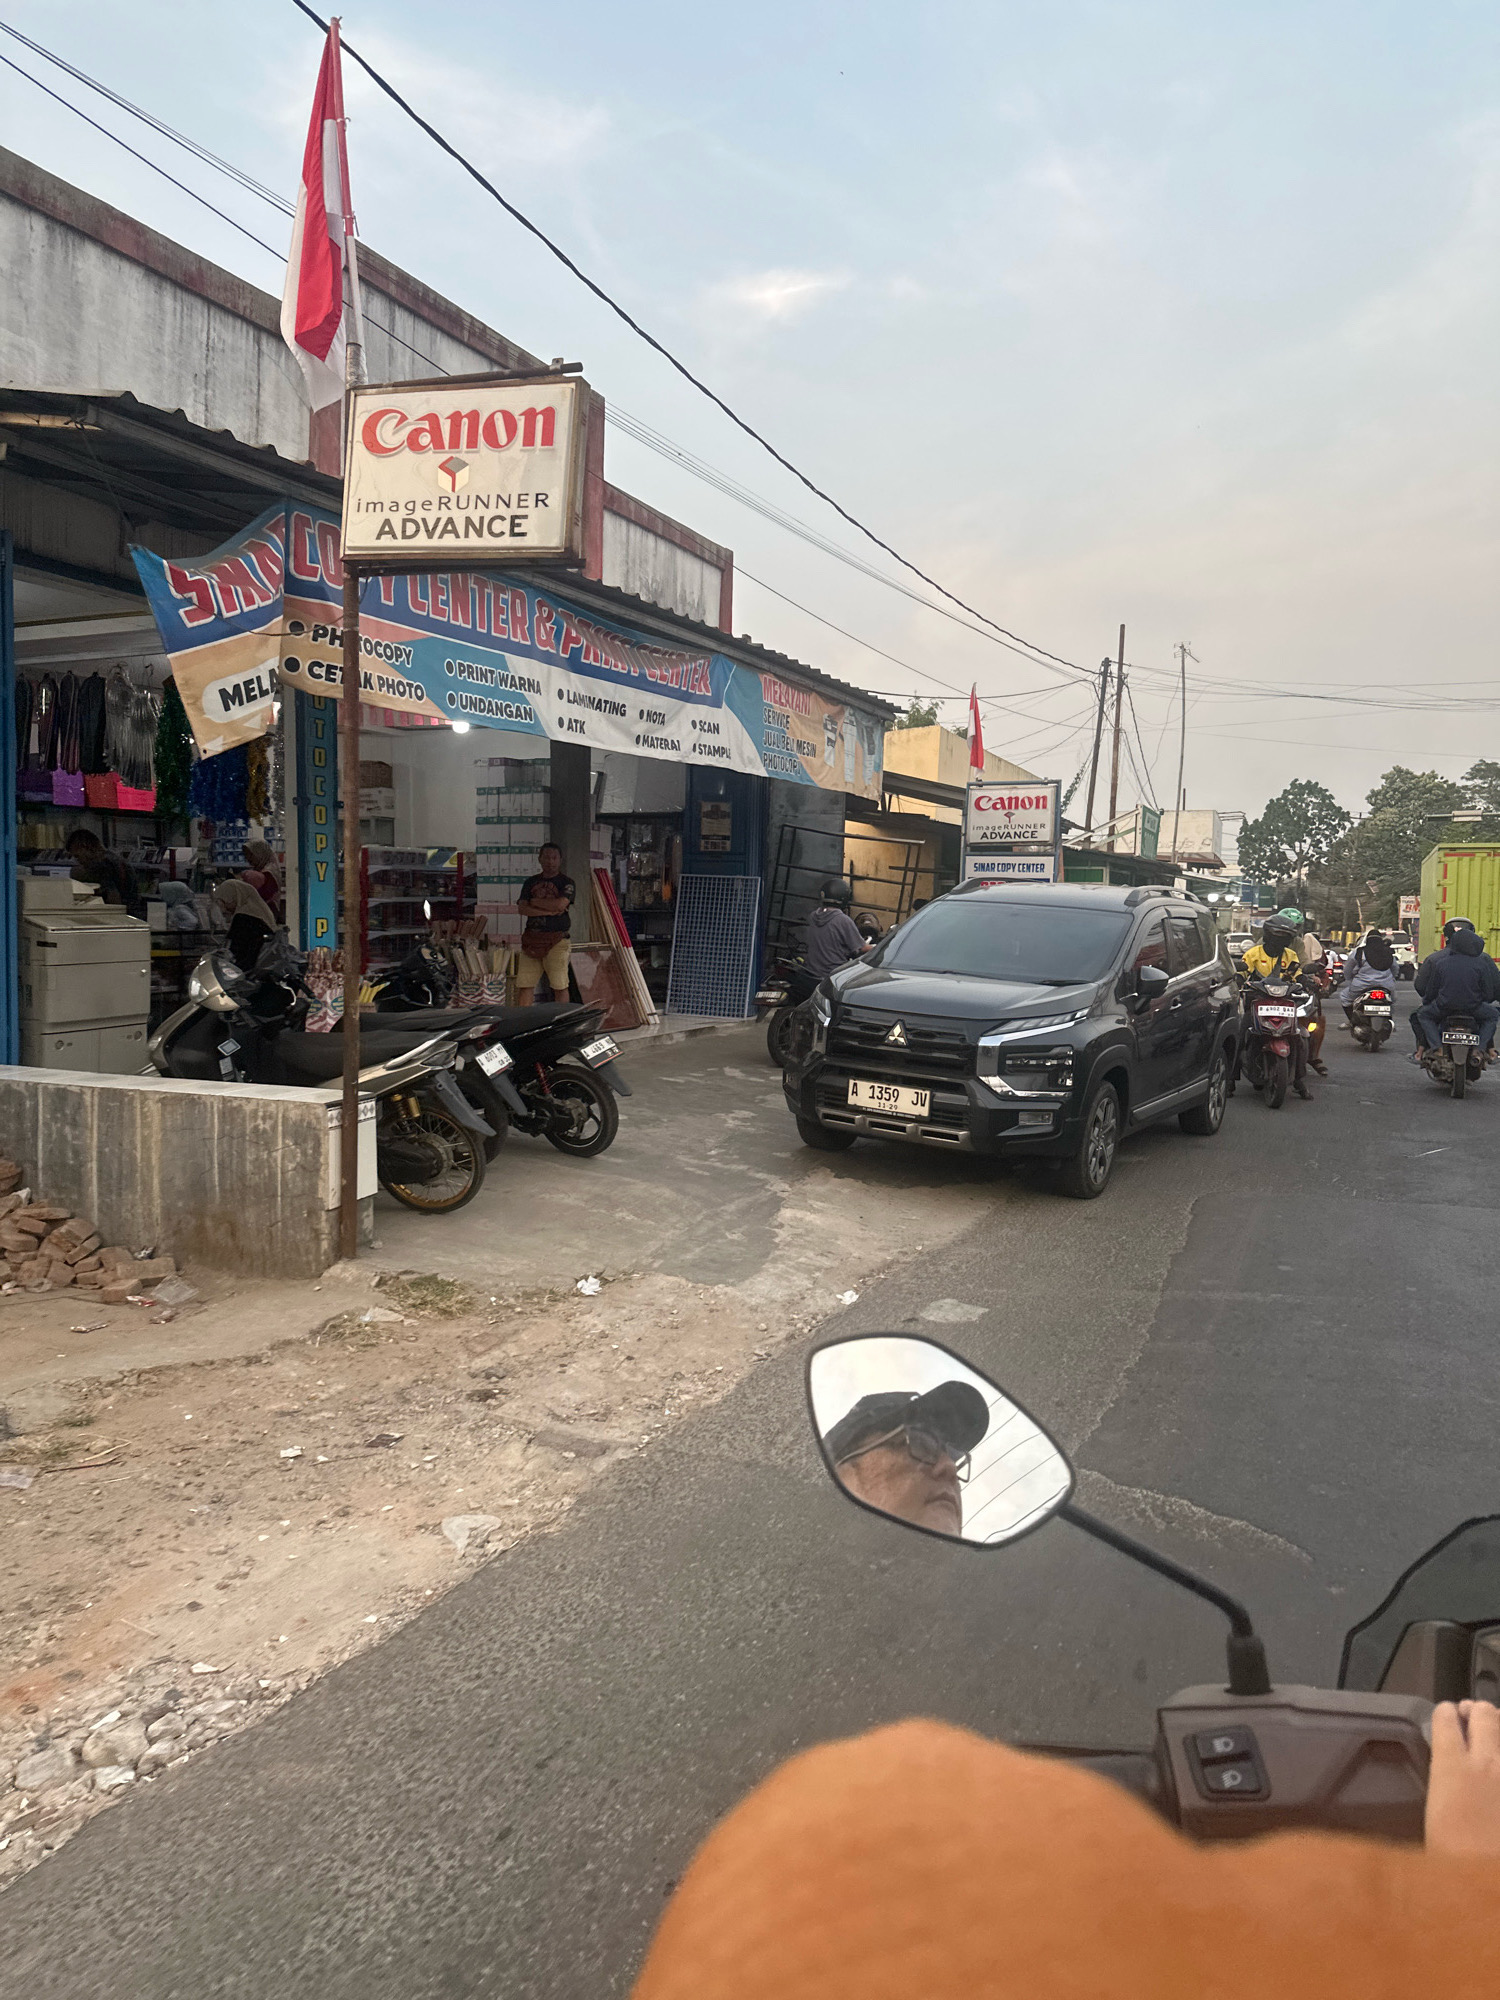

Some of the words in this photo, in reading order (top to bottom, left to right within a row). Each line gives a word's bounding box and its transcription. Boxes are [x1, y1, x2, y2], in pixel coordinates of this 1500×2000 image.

[361, 405, 556, 455] Canon
[356, 492, 550, 516] imageRUNNER
[375, 514, 529, 541] ADVANCE
[407, 572, 531, 645] CENTER
[534, 597, 557, 654] &
[376, 674, 426, 703] PHOTO
[457, 661, 497, 686] PRINT
[497, 671, 542, 696] WARNA
[458, 693, 535, 723] UNDANGAN
[566, 689, 627, 717] LAMINATING
[762, 675, 811, 717] MELAYANI
[566, 718, 586, 735] ATK
[646, 709, 666, 726] NOTA
[698, 720, 720, 735] SCAN
[763, 706, 790, 730] SERVICE
[642, 734, 681, 751] MATERAI
[763, 730, 781, 749] JUAL
[796, 739, 817, 758] MESIN
[974, 795, 1048, 812] Canon
[972, 823, 1047, 832] imageRUNNER
[980, 830, 1039, 840] ADVANCE
[973, 862, 996, 873] SINAR
[996, 862, 1018, 873] COPY
[1017, 862, 1046, 873] CENTER
[850, 1082, 859, 1097] A
[868, 1084, 900, 1103] 1359
[911, 1091, 928, 1108] JV
